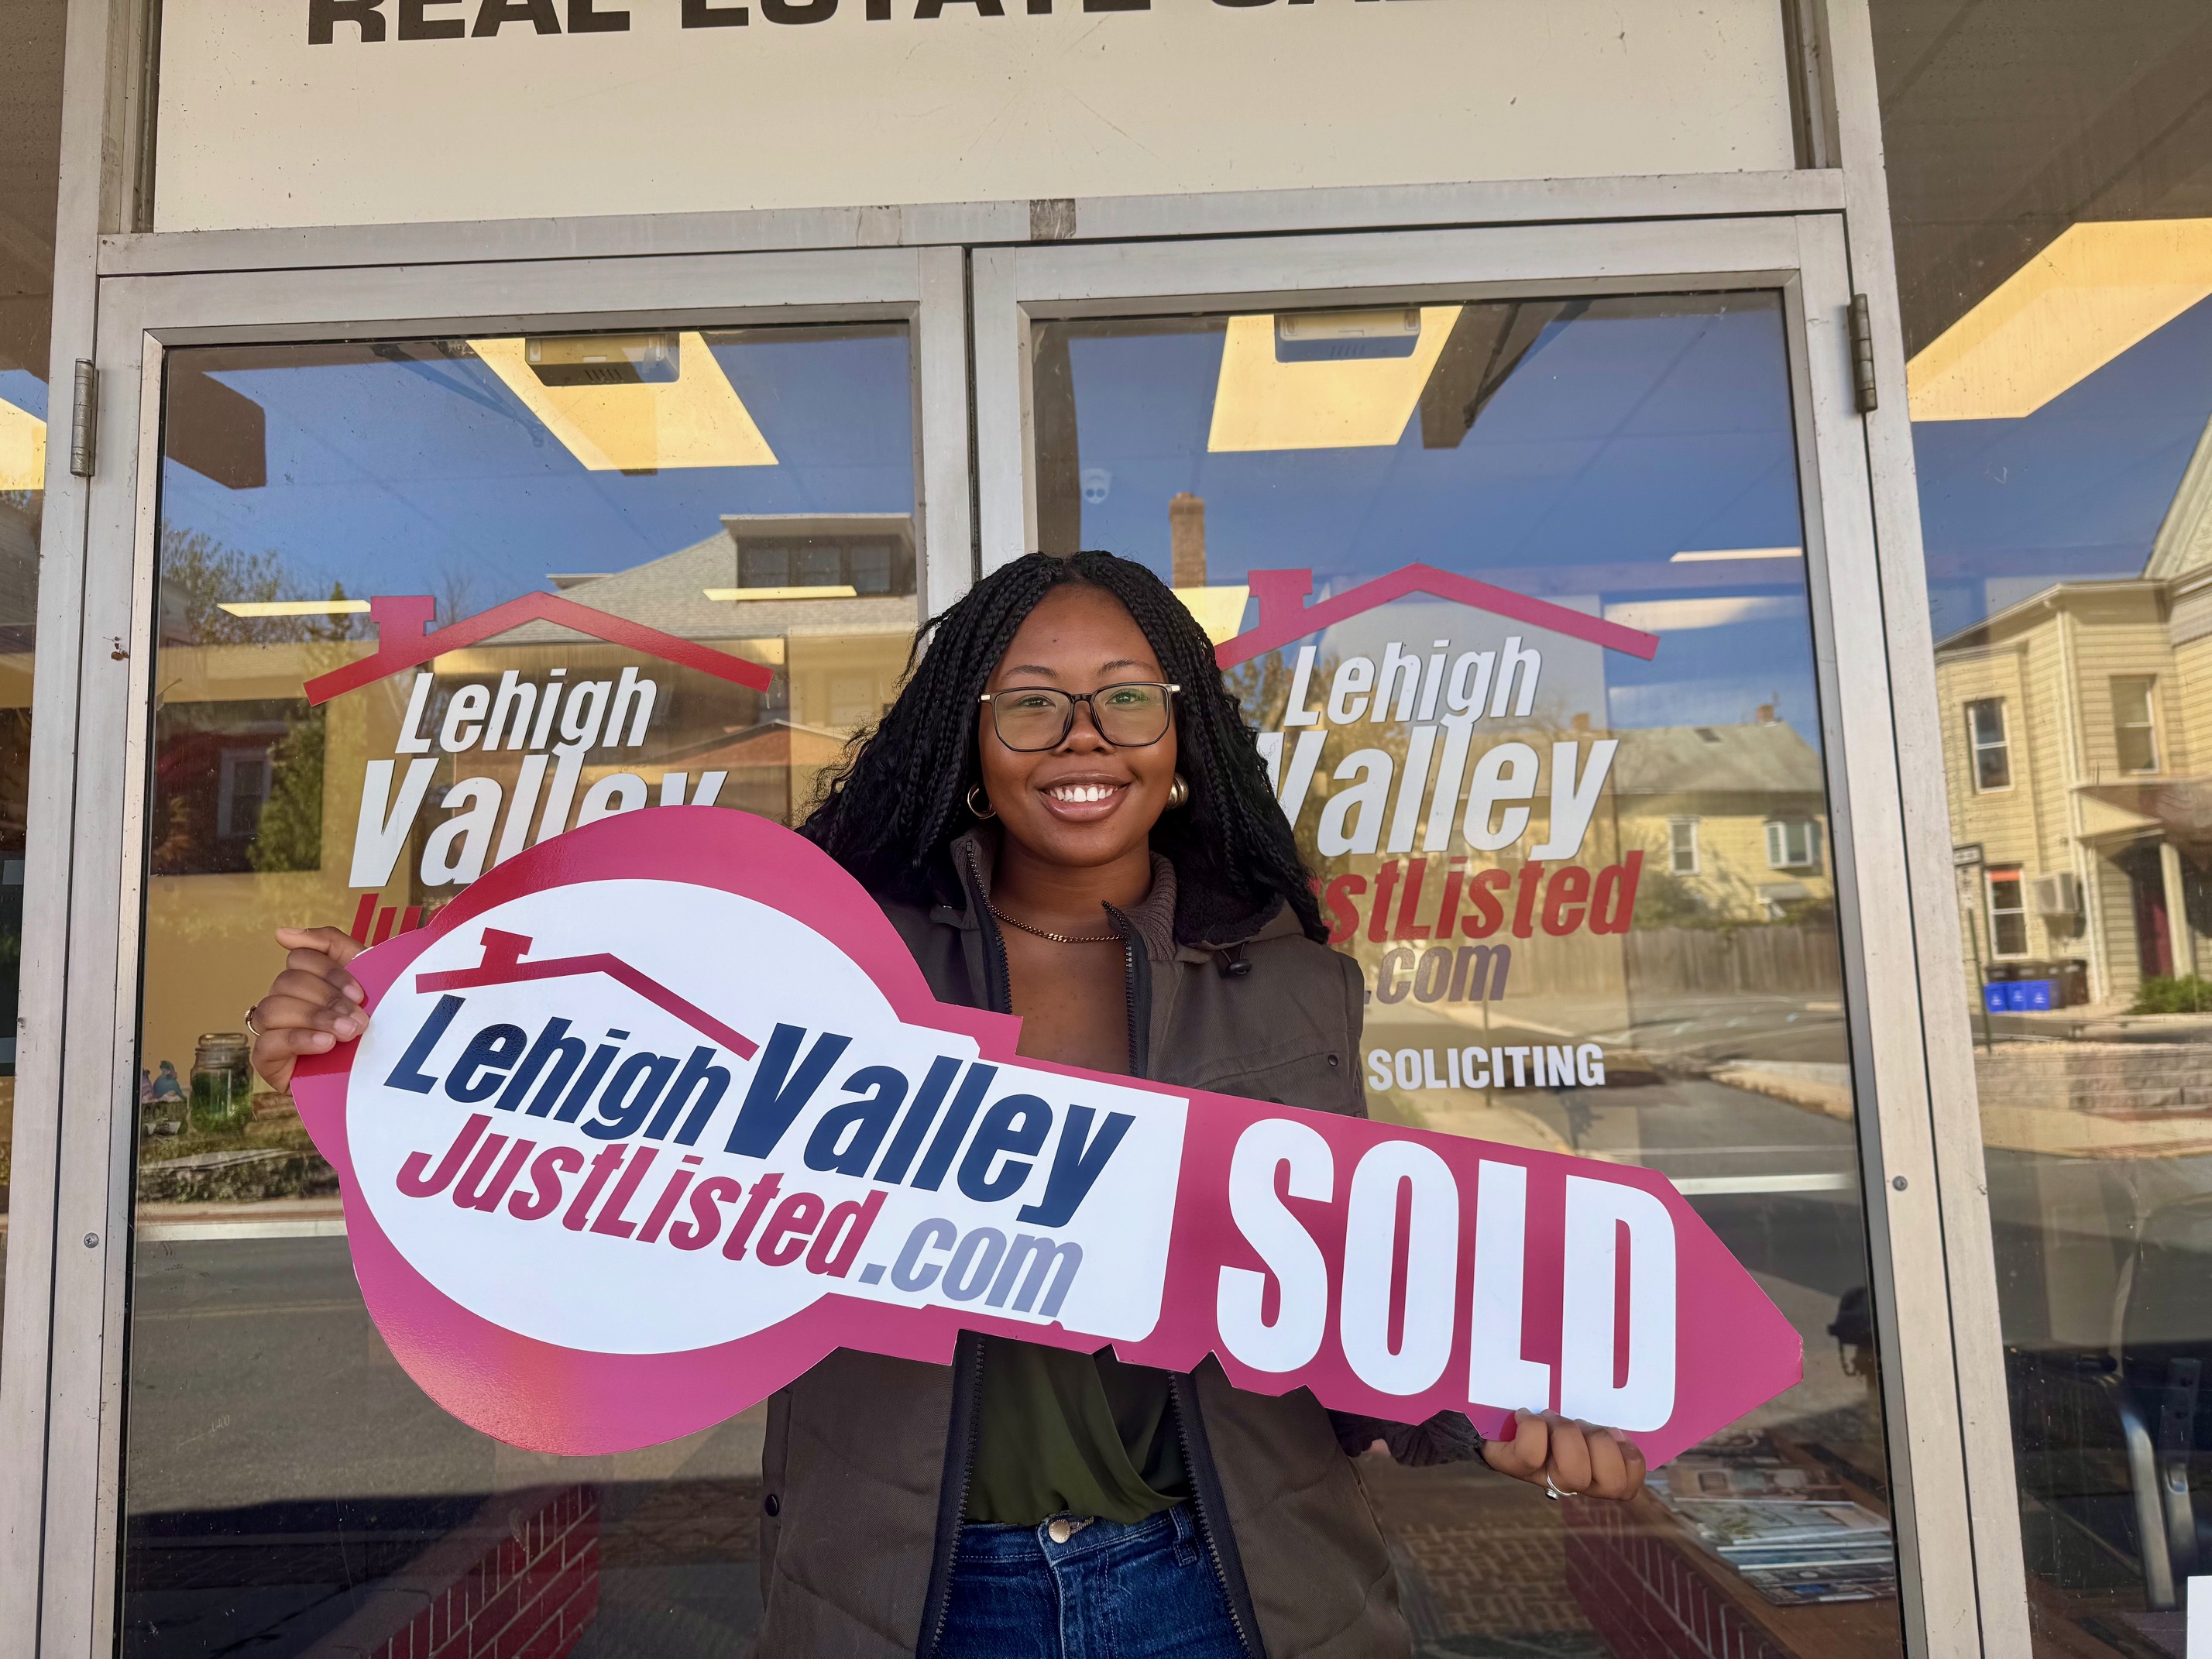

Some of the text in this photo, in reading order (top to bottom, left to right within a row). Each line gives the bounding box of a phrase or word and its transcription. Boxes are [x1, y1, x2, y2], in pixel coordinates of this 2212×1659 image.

[394, 666, 658, 756] Lehigh
[1284, 636, 1541, 727] Lehigh
[349, 754, 728, 888] Vall
[1307, 850, 1644, 945] stListed
[1367, 1042, 1606, 1091] SOLICITING
[1217, 1118, 1677, 1433] SOLD
